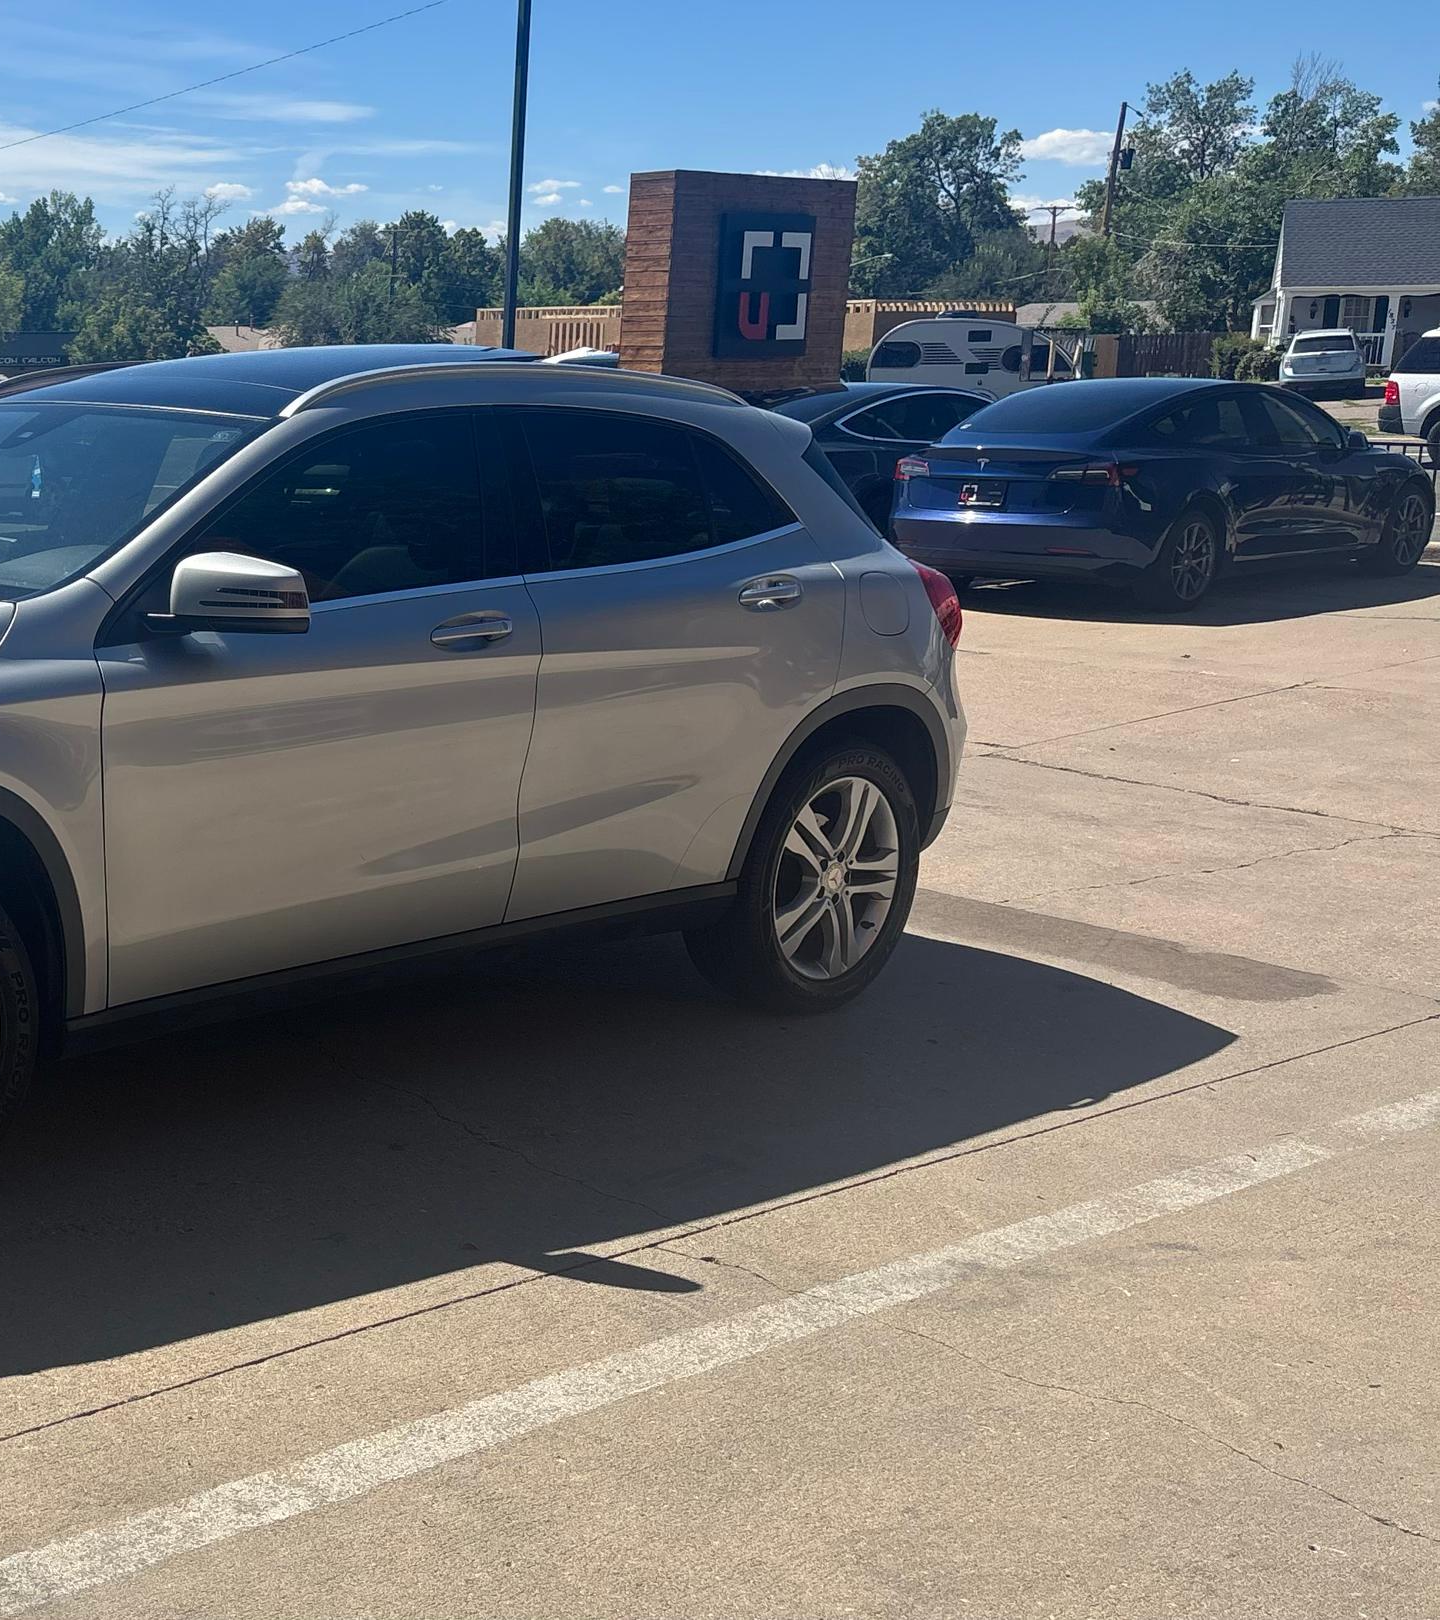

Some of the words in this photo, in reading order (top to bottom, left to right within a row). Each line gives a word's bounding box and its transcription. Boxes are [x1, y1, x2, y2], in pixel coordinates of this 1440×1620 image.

[838, 754, 864, 769] PRO
[866, 755, 905, 793] RACING
[9, 970, 31, 1023] PRO
